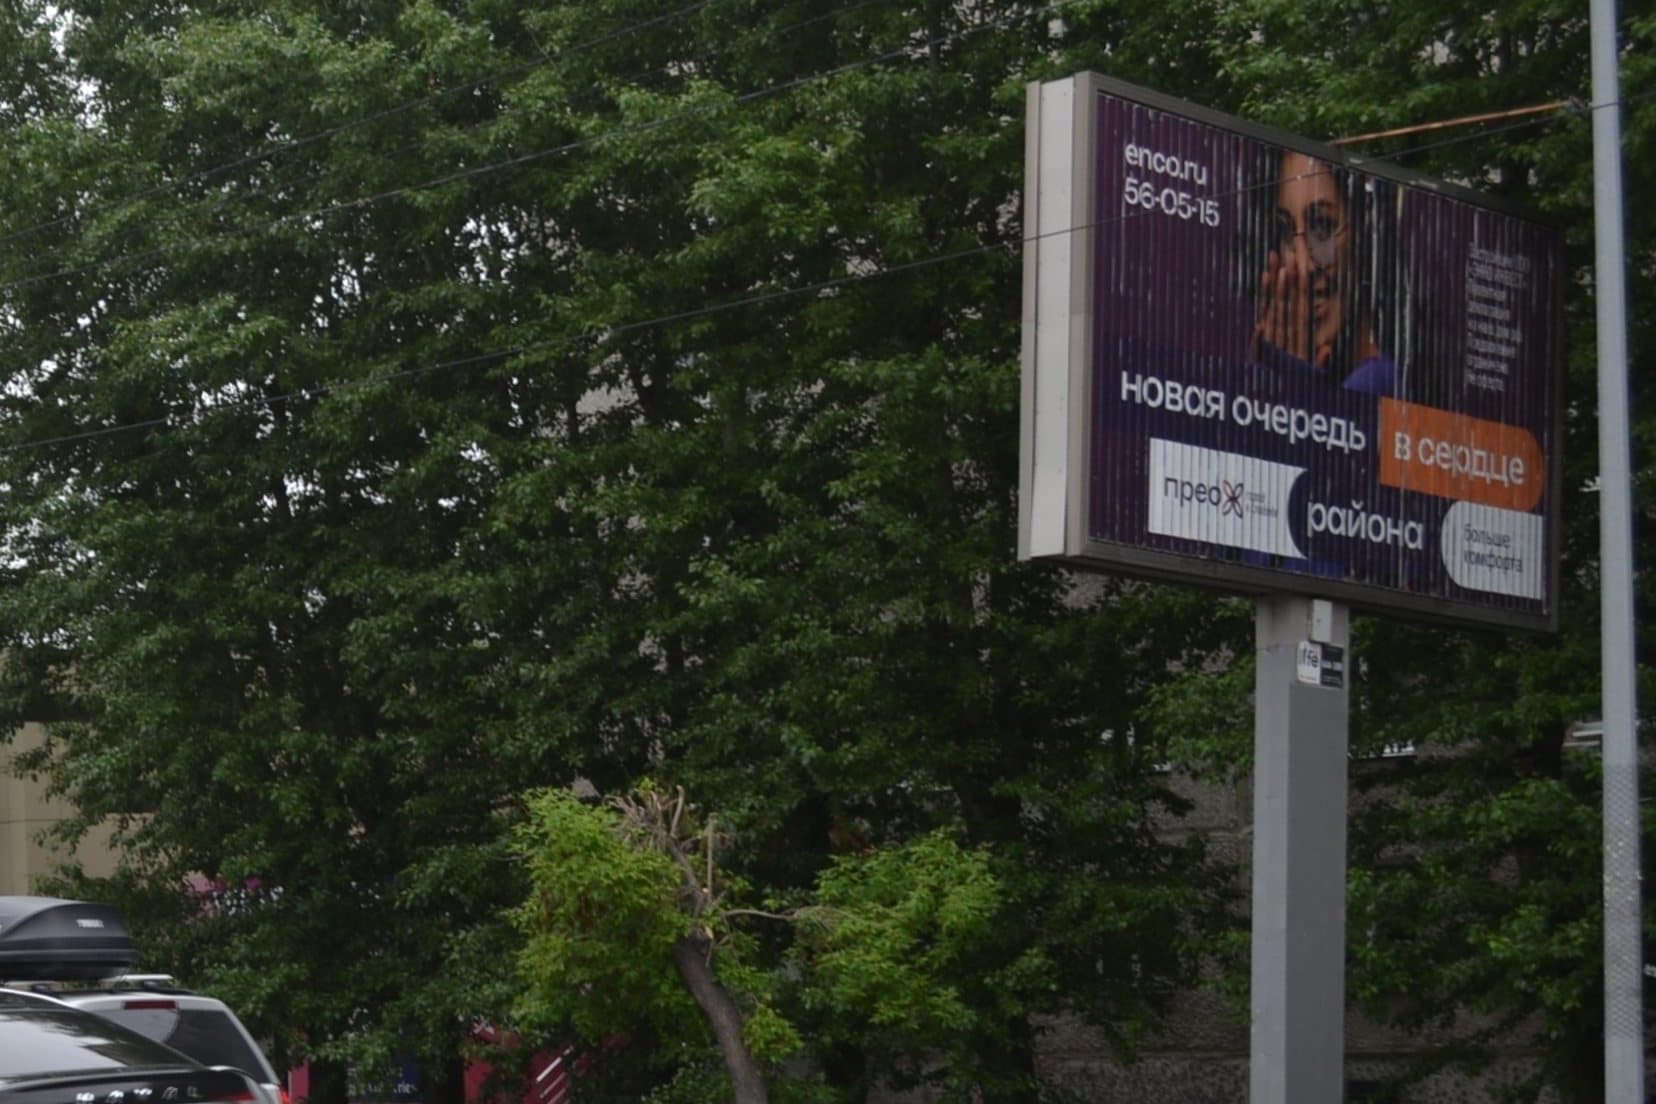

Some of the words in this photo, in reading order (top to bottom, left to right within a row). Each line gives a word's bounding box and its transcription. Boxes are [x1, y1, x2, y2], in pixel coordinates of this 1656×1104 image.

[1124, 143, 1207, 185] enco.ru
[1124, 177, 1220, 227] 56-05-15
[1121, 370, 1225, 421] новая
[1232, 395, 1366, 454] очередь
[1395, 431, 1411, 461] в
[1418, 437, 1524, 488] сердце
[1307, 499, 1424, 550] района
[1464, 523, 1511, 548] больше
[1464, 549, 1523, 575] комфорта
